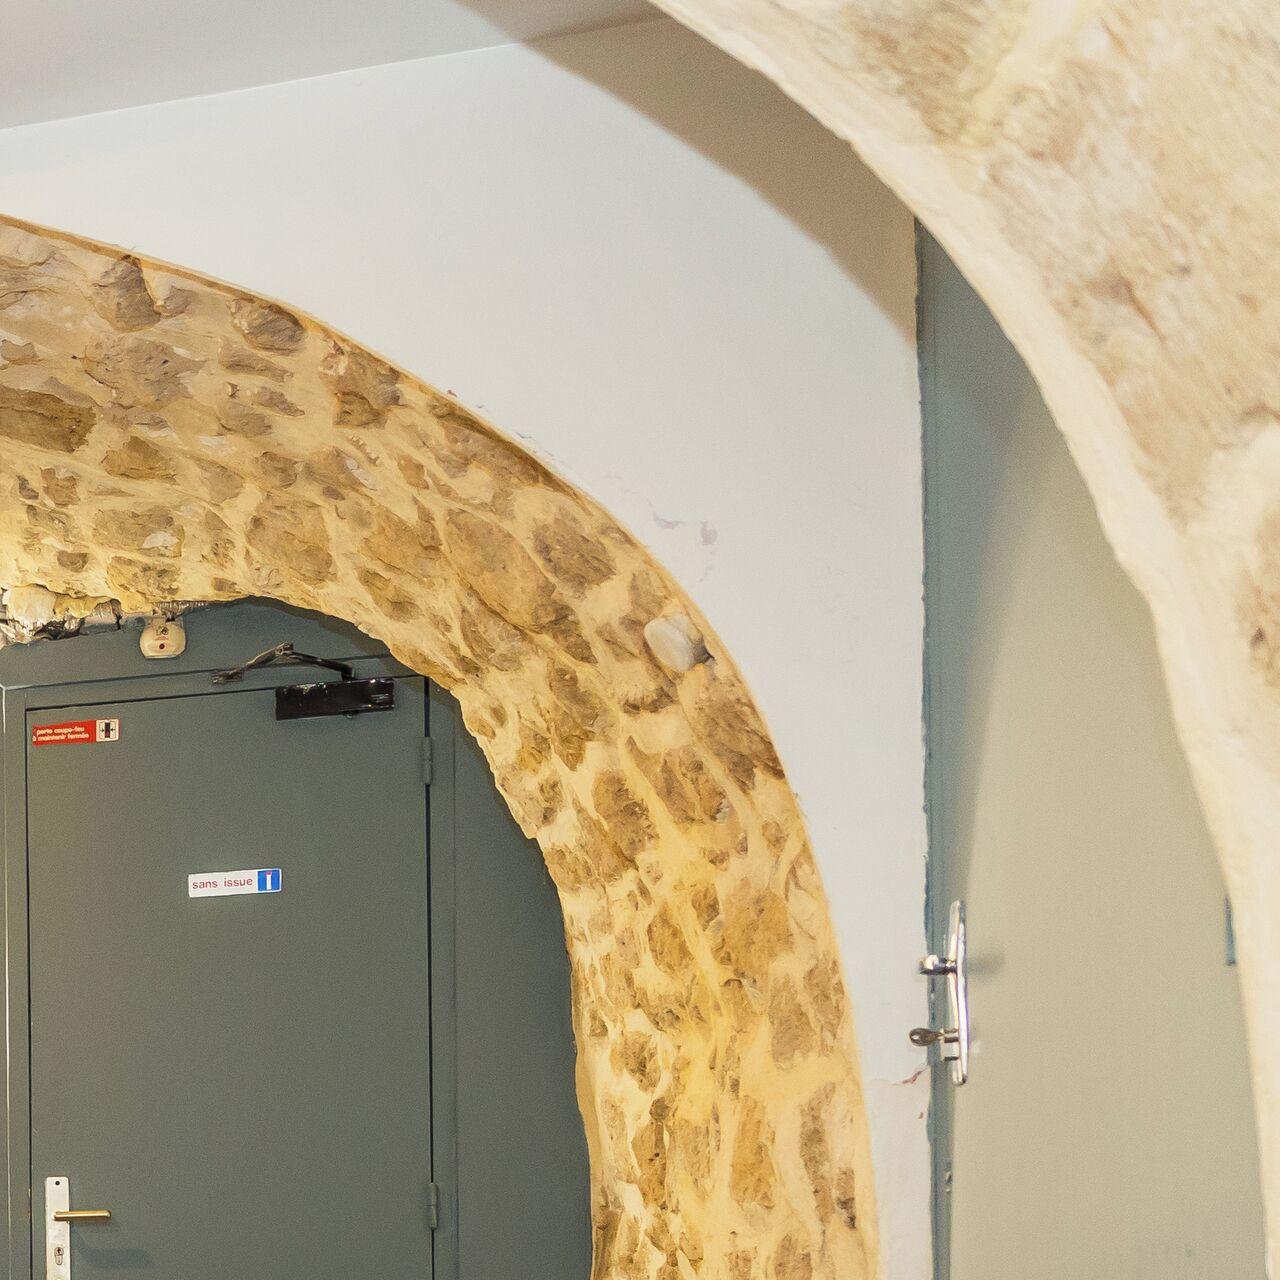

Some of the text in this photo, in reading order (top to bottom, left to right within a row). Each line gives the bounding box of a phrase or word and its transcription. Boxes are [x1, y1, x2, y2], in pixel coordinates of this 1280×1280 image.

[36, 728, 53, 737] porte
[192, 877, 253, 890] sans issue
